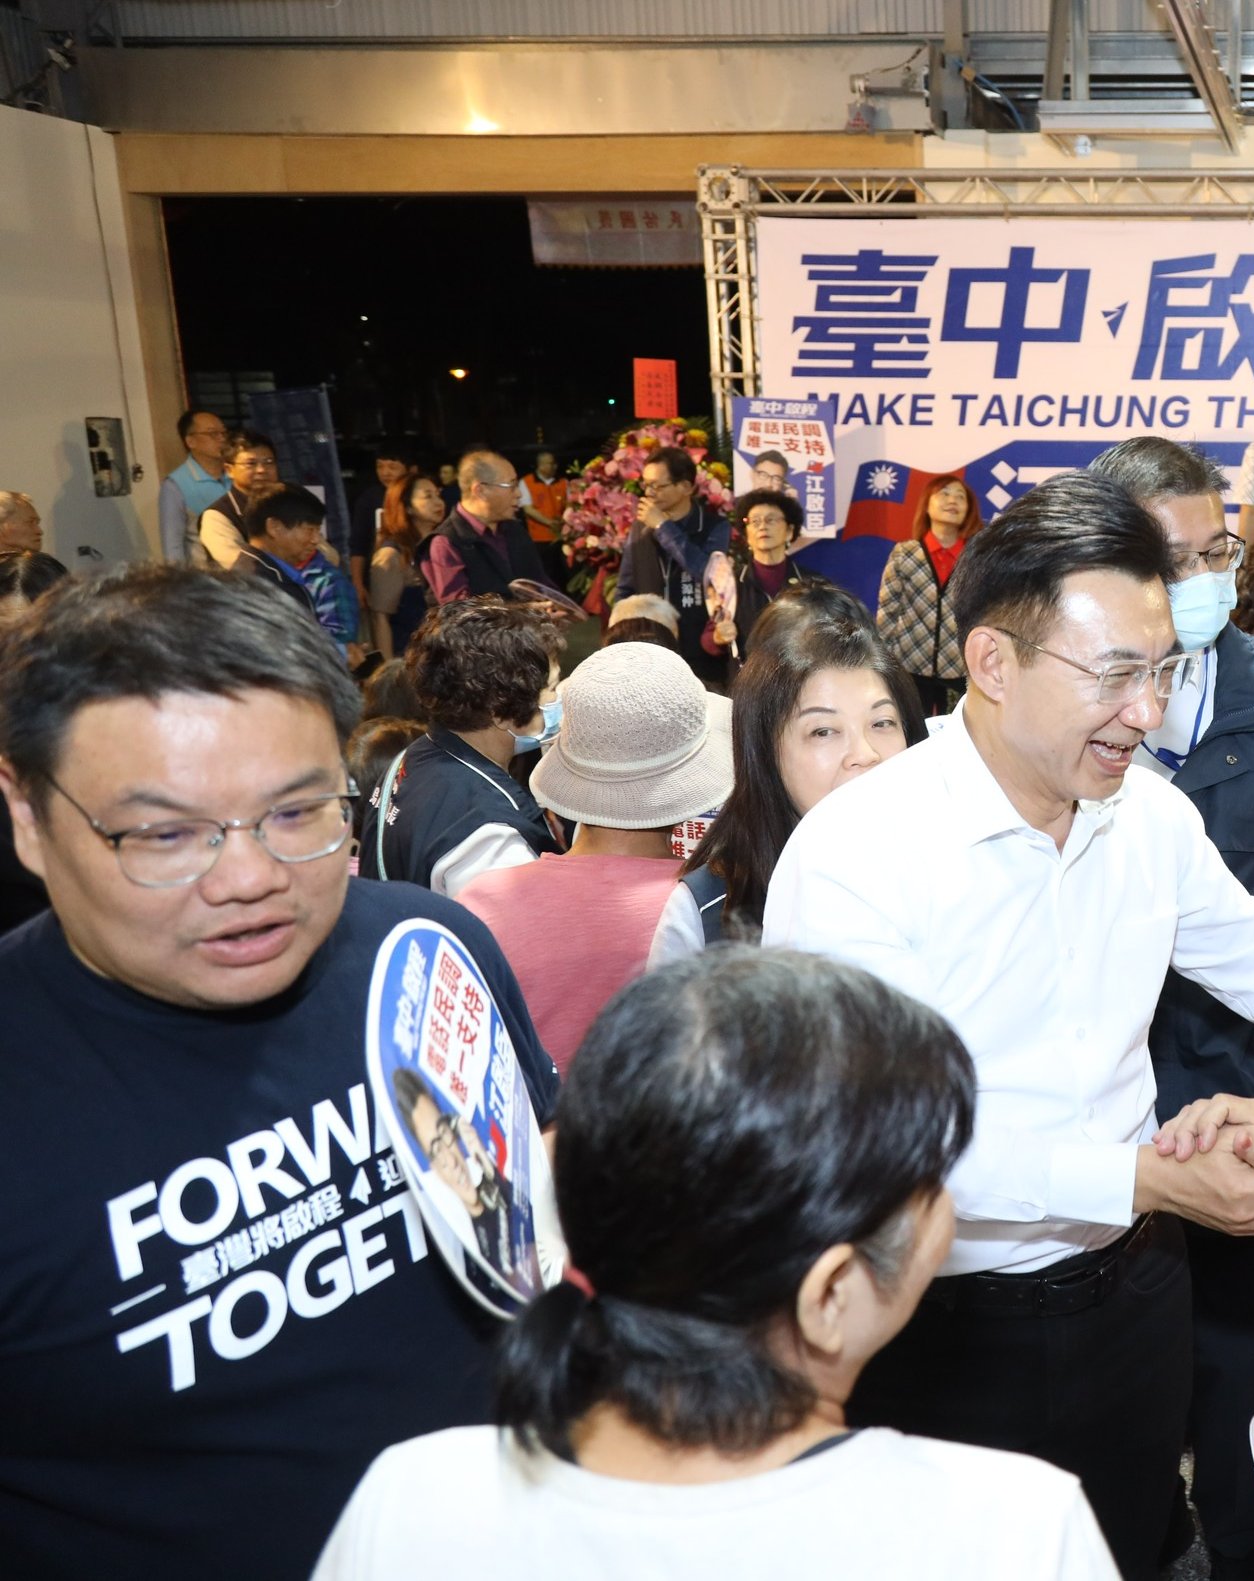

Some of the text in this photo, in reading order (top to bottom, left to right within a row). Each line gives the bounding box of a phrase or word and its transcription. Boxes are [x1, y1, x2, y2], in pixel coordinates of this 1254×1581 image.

[791, 246, 1091, 379] 臺中
[747, 435, 825, 456] 唯一支持
[749, 421, 822, 437] 電話民調
[951, 394, 1191, 428] TAICHUNG
[806, 475, 825, 531] 江啟臣
[427, 951, 462, 1076] 電話民調
[450, 983, 484, 1106] 唯一支持
[116, 1190, 428, 1393] TOGET
[180, 1184, 344, 1295] 臺灣將啟程
